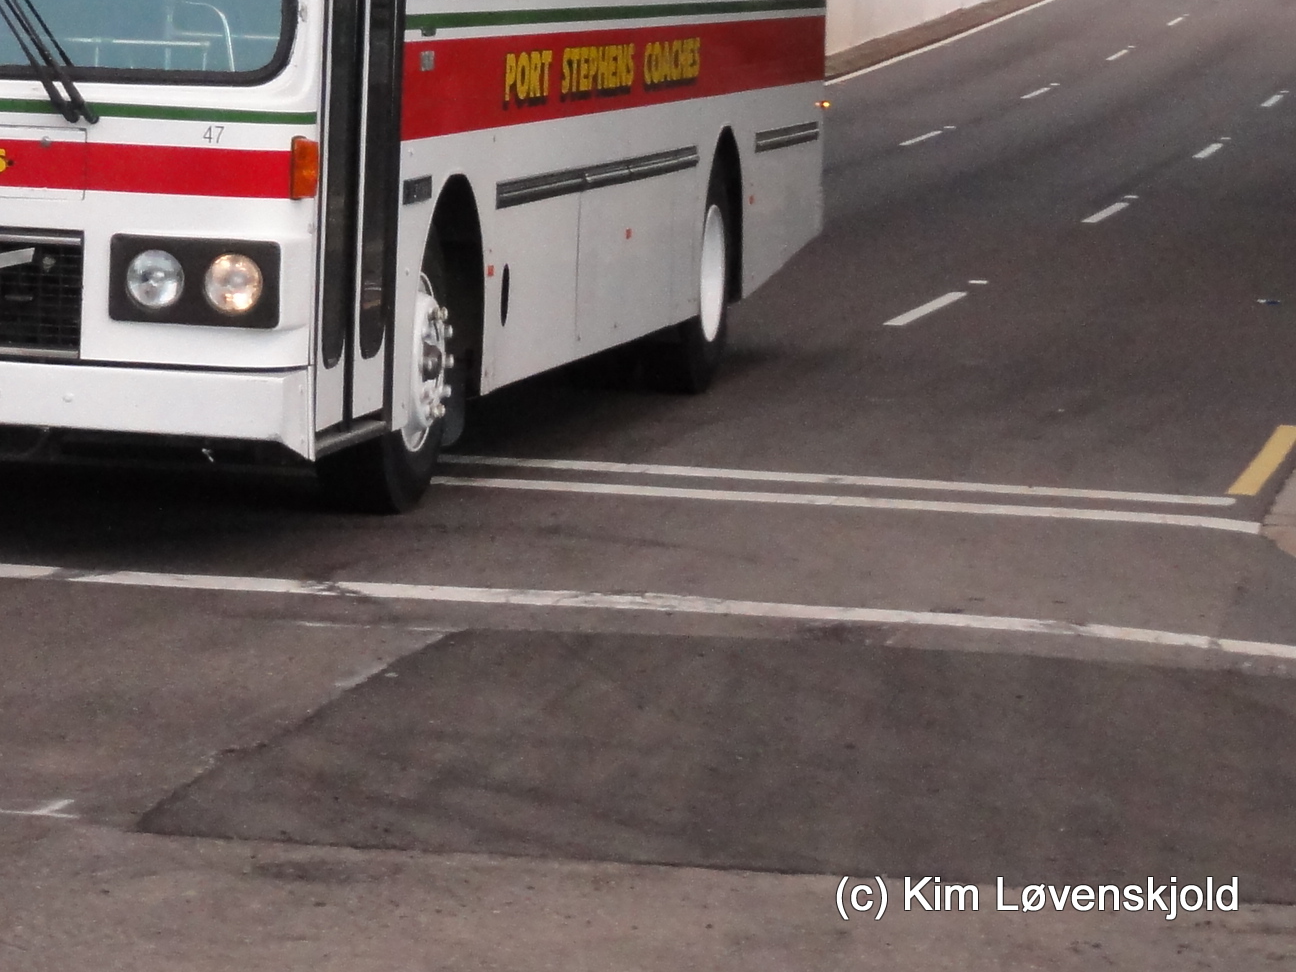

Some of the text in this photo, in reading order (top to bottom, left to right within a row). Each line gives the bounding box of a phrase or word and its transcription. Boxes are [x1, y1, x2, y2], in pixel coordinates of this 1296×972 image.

[505, 37, 701, 102] PORT STEPHENS COACHES
[202, 125, 225, 144] 47
